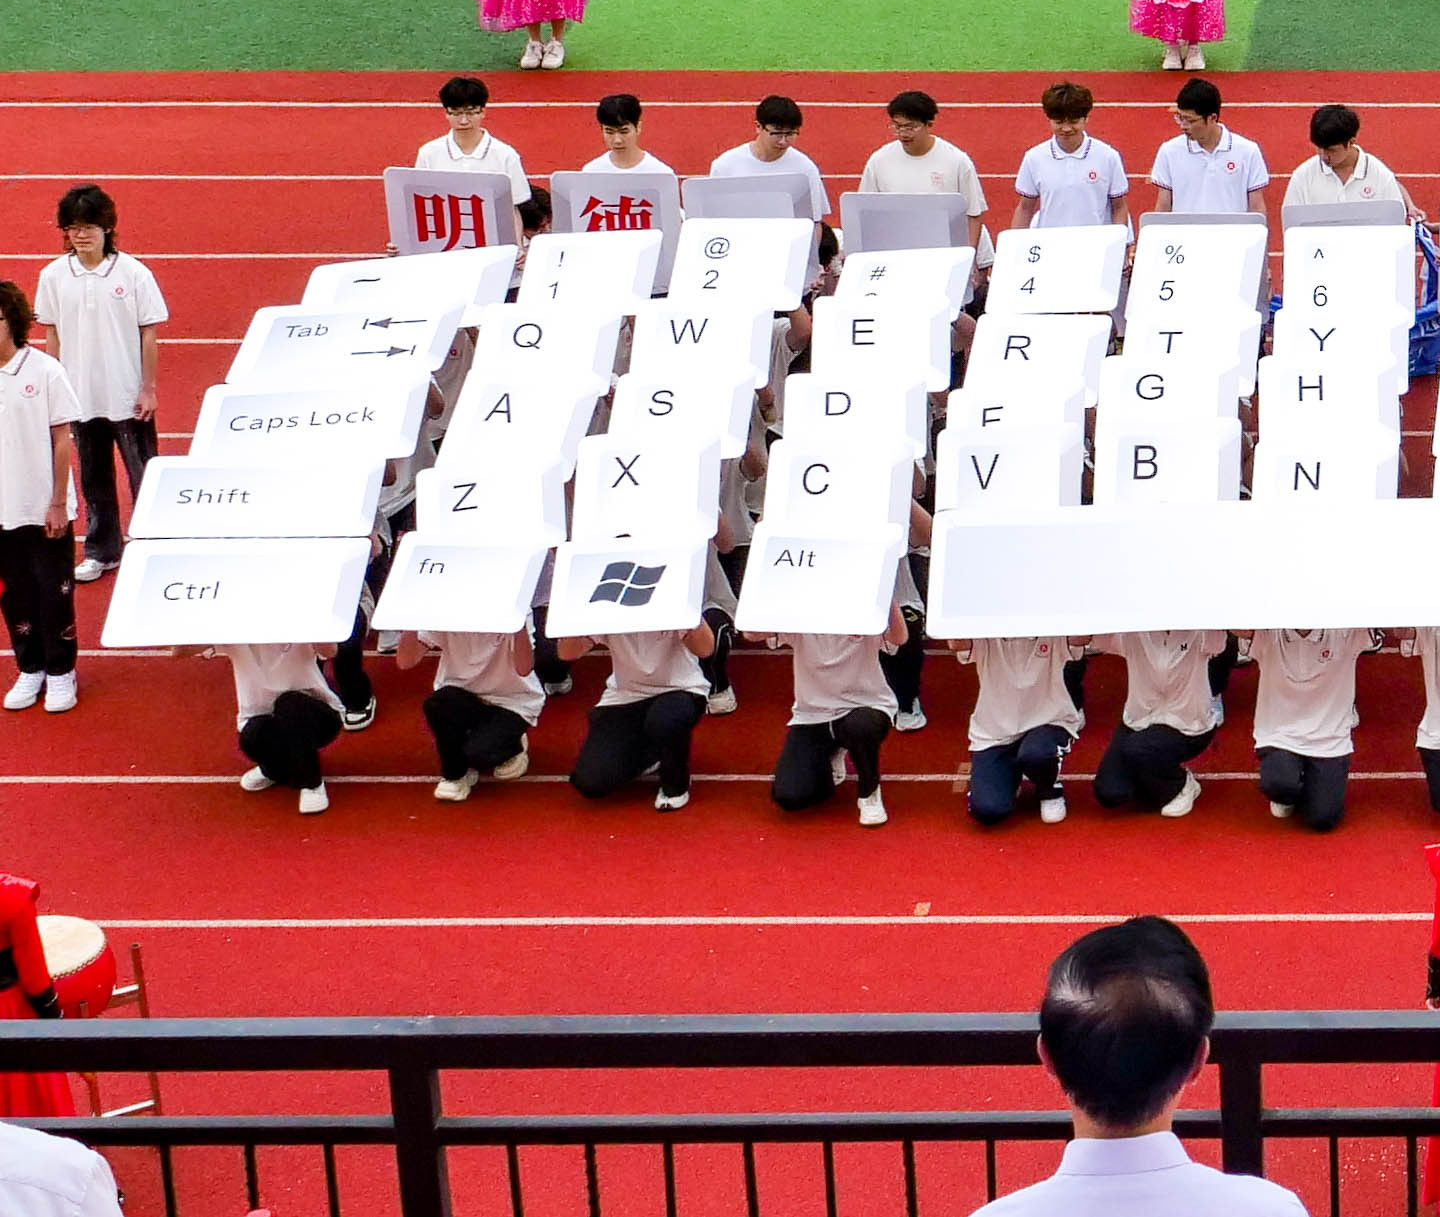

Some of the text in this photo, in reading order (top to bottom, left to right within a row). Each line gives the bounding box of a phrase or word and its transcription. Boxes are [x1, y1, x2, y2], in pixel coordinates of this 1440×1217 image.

[413, 193, 486, 252] 明
[704, 237, 730, 260] @
[1028, 245, 1041, 263] $
[1165, 245, 1185, 265] %
[702, 269, 719, 290] 2
[870, 266, 886, 281] #
[1020, 277, 1035, 295] 4
[547, 280, 559, 300] 1
[1159, 280, 1175, 301] 5
[1313, 285, 1328, 307] 6
[287, 324, 329, 338] Tab
[513, 323, 543, 350] Q
[670, 318, 709, 345] W
[852, 318, 875, 346] E
[1159, 331, 1183, 354] T
[1309, 327, 1336, 352] Y
[1003, 335, 1031, 361] R
[1135, 374, 1165, 401] G
[1298, 375, 1323, 402] H
[484, 393, 511, 424] A
[648, 390, 674, 416] S
[825, 391, 852, 416] D
[230, 407, 373, 433] Caps Lock
[982, 406, 1004, 427] F
[611, 454, 641, 489] X
[970, 453, 1000, 490] V
[1133, 445, 1158, 480] B
[802, 463, 830, 495] C
[1293, 461, 1321, 491] N
[176, 488, 251, 505] Shift
[452, 482, 478, 512] Z
[419, 558, 445, 574] fn
[774, 549, 816, 568] Alt
[163, 581, 220, 601] Ctrl
